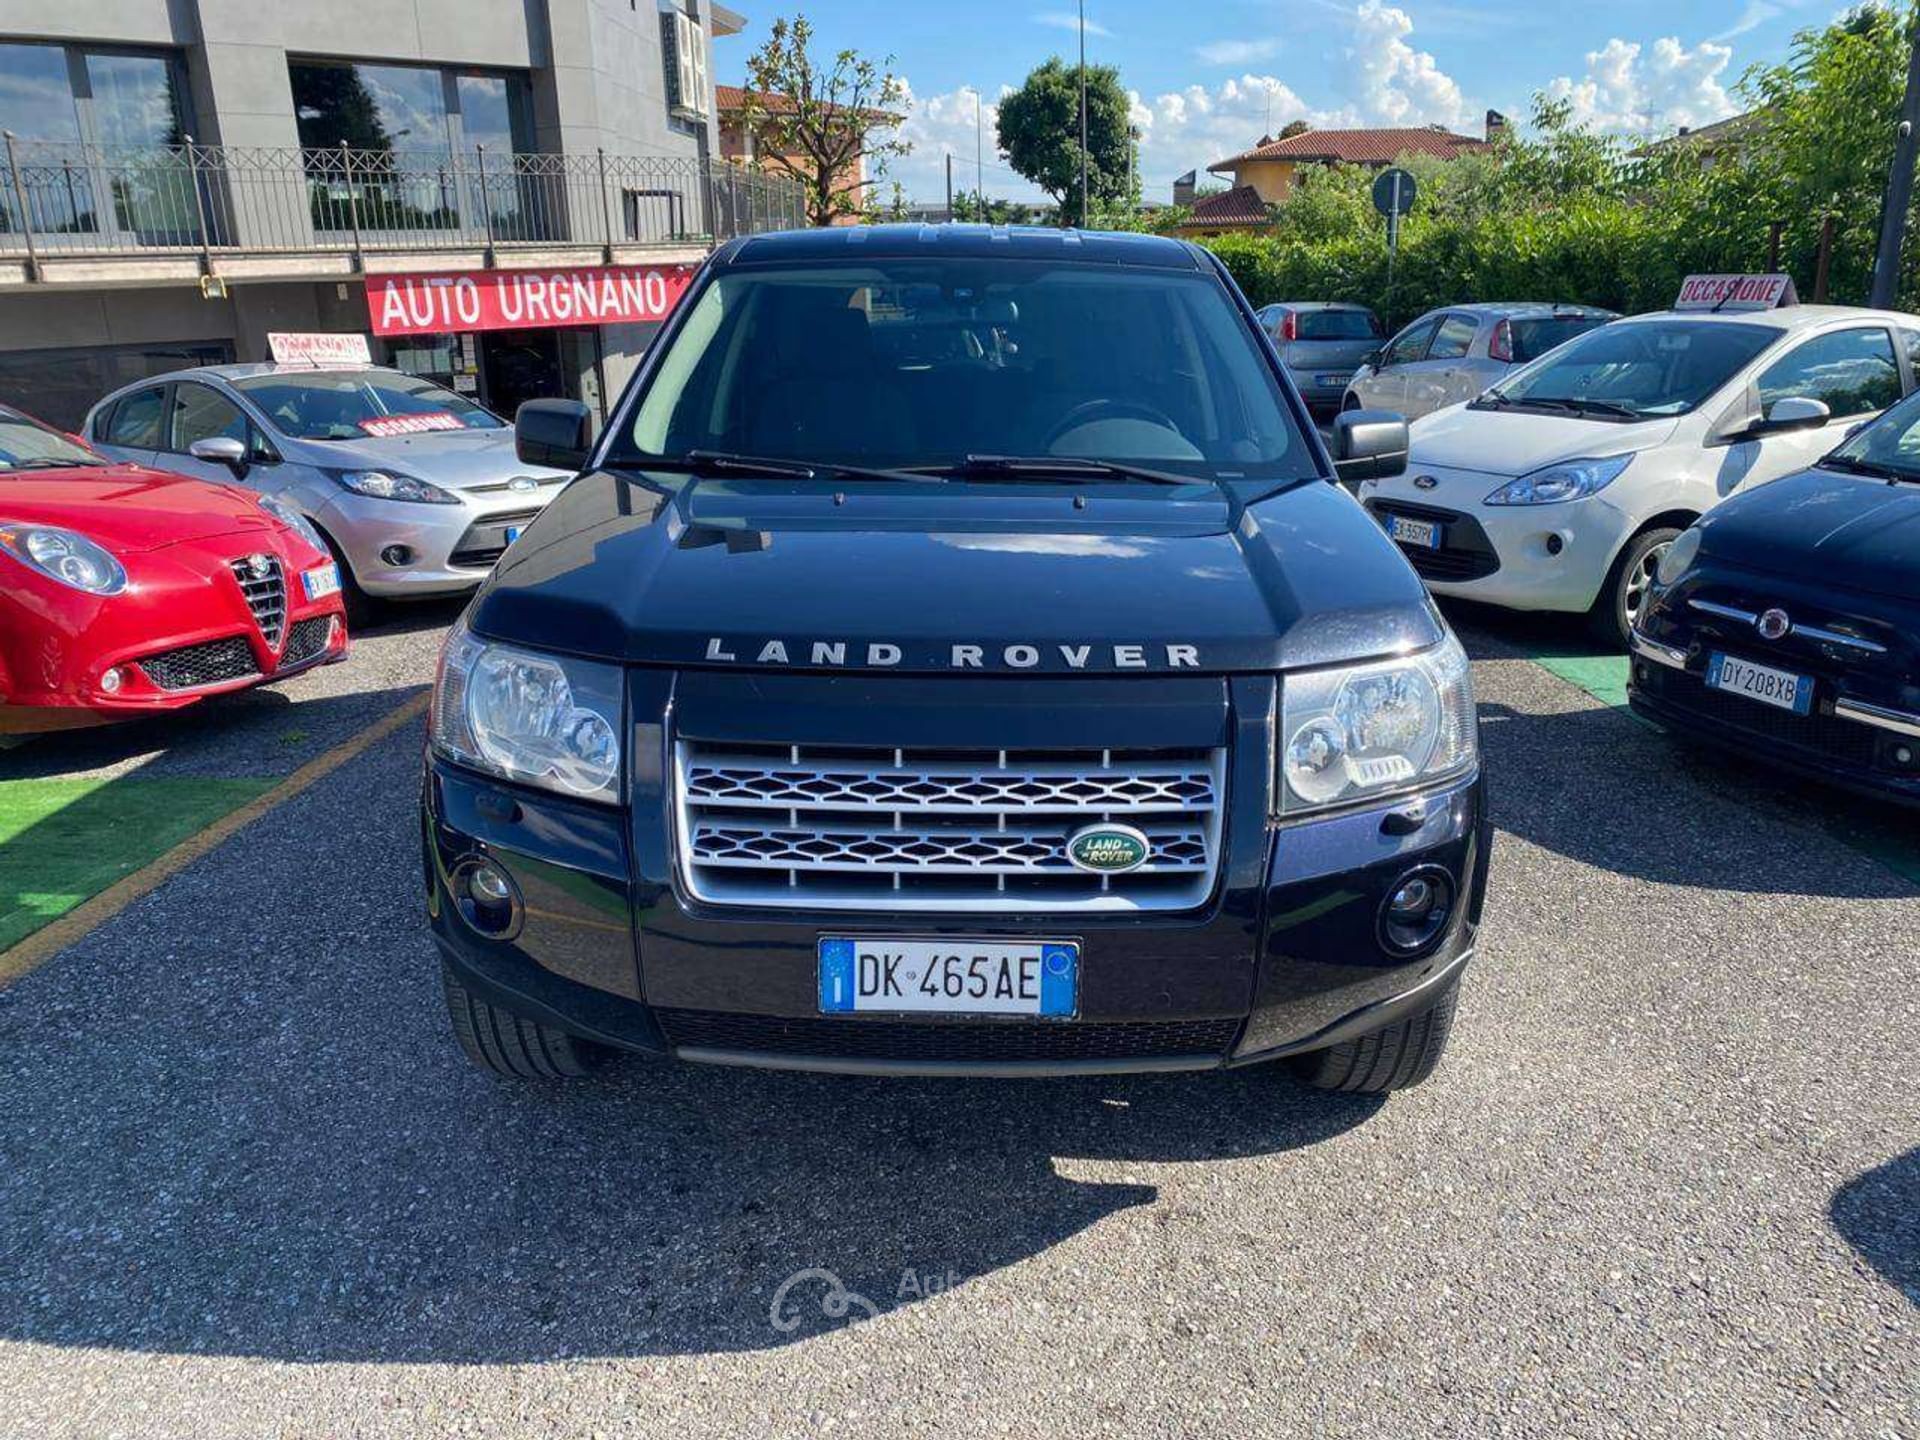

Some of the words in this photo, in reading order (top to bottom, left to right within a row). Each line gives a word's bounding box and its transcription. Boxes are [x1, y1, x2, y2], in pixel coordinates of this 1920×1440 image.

[382, 278, 479, 329] AUTO
[497, 271, 667, 322] URGNANO
[1680, 279, 1780, 302] OCCASIONE
[705, 638, 902, 666] LAND
[951, 644, 1201, 668] ROVER
[1723, 661, 1743, 685] DY
[1745, 669, 1795, 701] 208XB
[1086, 839, 1122, 850] LAND
[1089, 850, 1134, 862] ROVER
[859, 954, 903, 997] DK
[919, 955, 1041, 1000] 465AE
